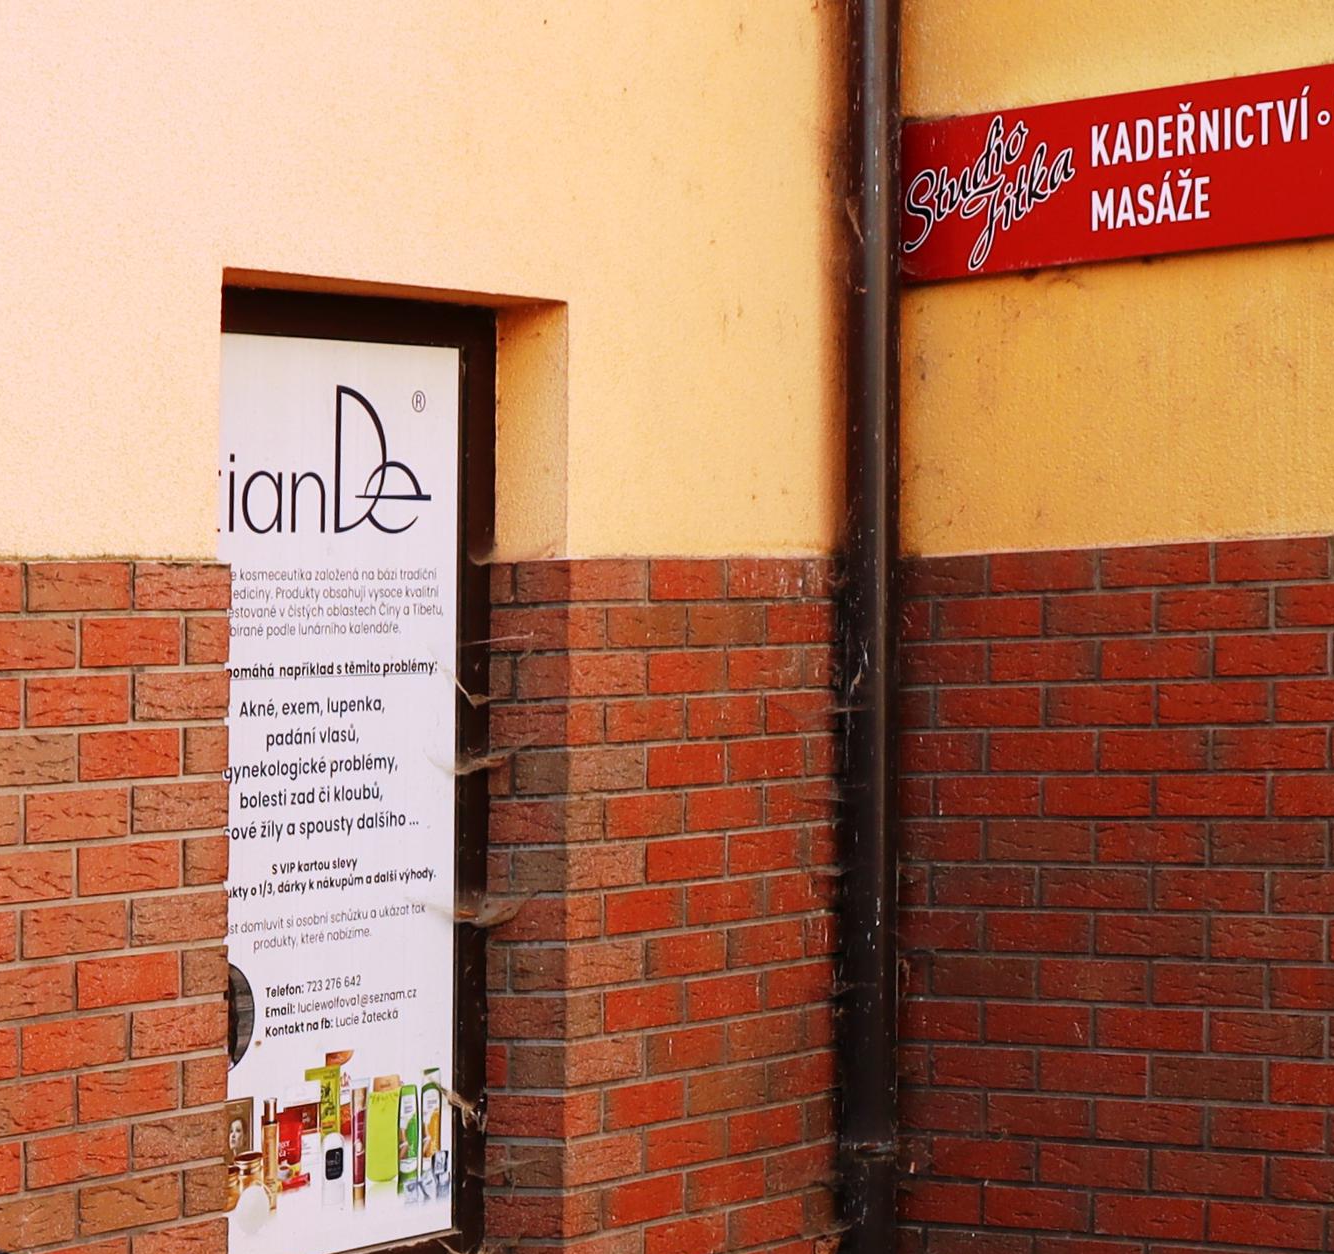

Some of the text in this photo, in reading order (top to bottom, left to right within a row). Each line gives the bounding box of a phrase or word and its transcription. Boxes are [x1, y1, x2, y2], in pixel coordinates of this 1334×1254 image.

[1090, 86, 1309, 167] KADEŘNICTVÍ
[903, 115, 1029, 253] Studio
[960, 142, 1076, 271] Jitka
[1090, 168, 1211, 232] MASÁŽE
[240, 568, 312, 581] kosmeceutika
[315, 567, 359, 581] založená
[361, 569, 375, 580] na
[275, 586, 320, 602] Produkty
[368, 589, 403, 602] vysoce
[405, 584, 440, 598] kvalitní
[279, 608, 286, 617] v
[288, 605, 324, 621] čistých
[326, 603, 377, 617] oblastech
[403, 605, 410, 616] a
[412, 602, 444, 617] Tibetu,
[266, 623, 296, 640] podle
[298, 621, 347, 637] lunárního
[279, 661, 335, 681] například
[336, 664, 343, 675] s
[383, 657, 438, 677] problémy:
[239, 695, 386, 719] Akné, exem, lupenka,
[266, 723, 360, 752] padání vlasů,
[223, 752, 398, 785] gynekologické problémy,
[240, 780, 384, 810] bolesti zad či kloubů,
[260, 820, 284, 842] žíly
[286, 822, 296, 836] a
[298, 815, 354, 840] spousty
[356, 810, 407, 830] dalšího
[271, 857, 358, 876] S VIP kartou slevy
[250, 887, 257, 897] o
[258, 879, 276, 898] 1/3,
[277, 878, 307, 895] dárky
[308, 877, 315, 890] k
[316, 873, 365, 892] nákupům
[365, 874, 373, 885] a
[398, 866, 437, 884] výhody.
[240, 916, 284, 934] domluvit
[286, 914, 295, 929] si
[370, 908, 378, 919] a
[253, 935, 300, 954] produkty,
[300, 930, 325, 945] které
[265, 974, 362, 998] Telefon: 723 276 642
[265, 1002, 296, 1018] Email:
[265, 1020, 305, 1038] Kontakt
[306, 1021, 319, 1032] na
[320, 1017, 334, 1030] fb:
[335, 1012, 360, 1029] Lucie
